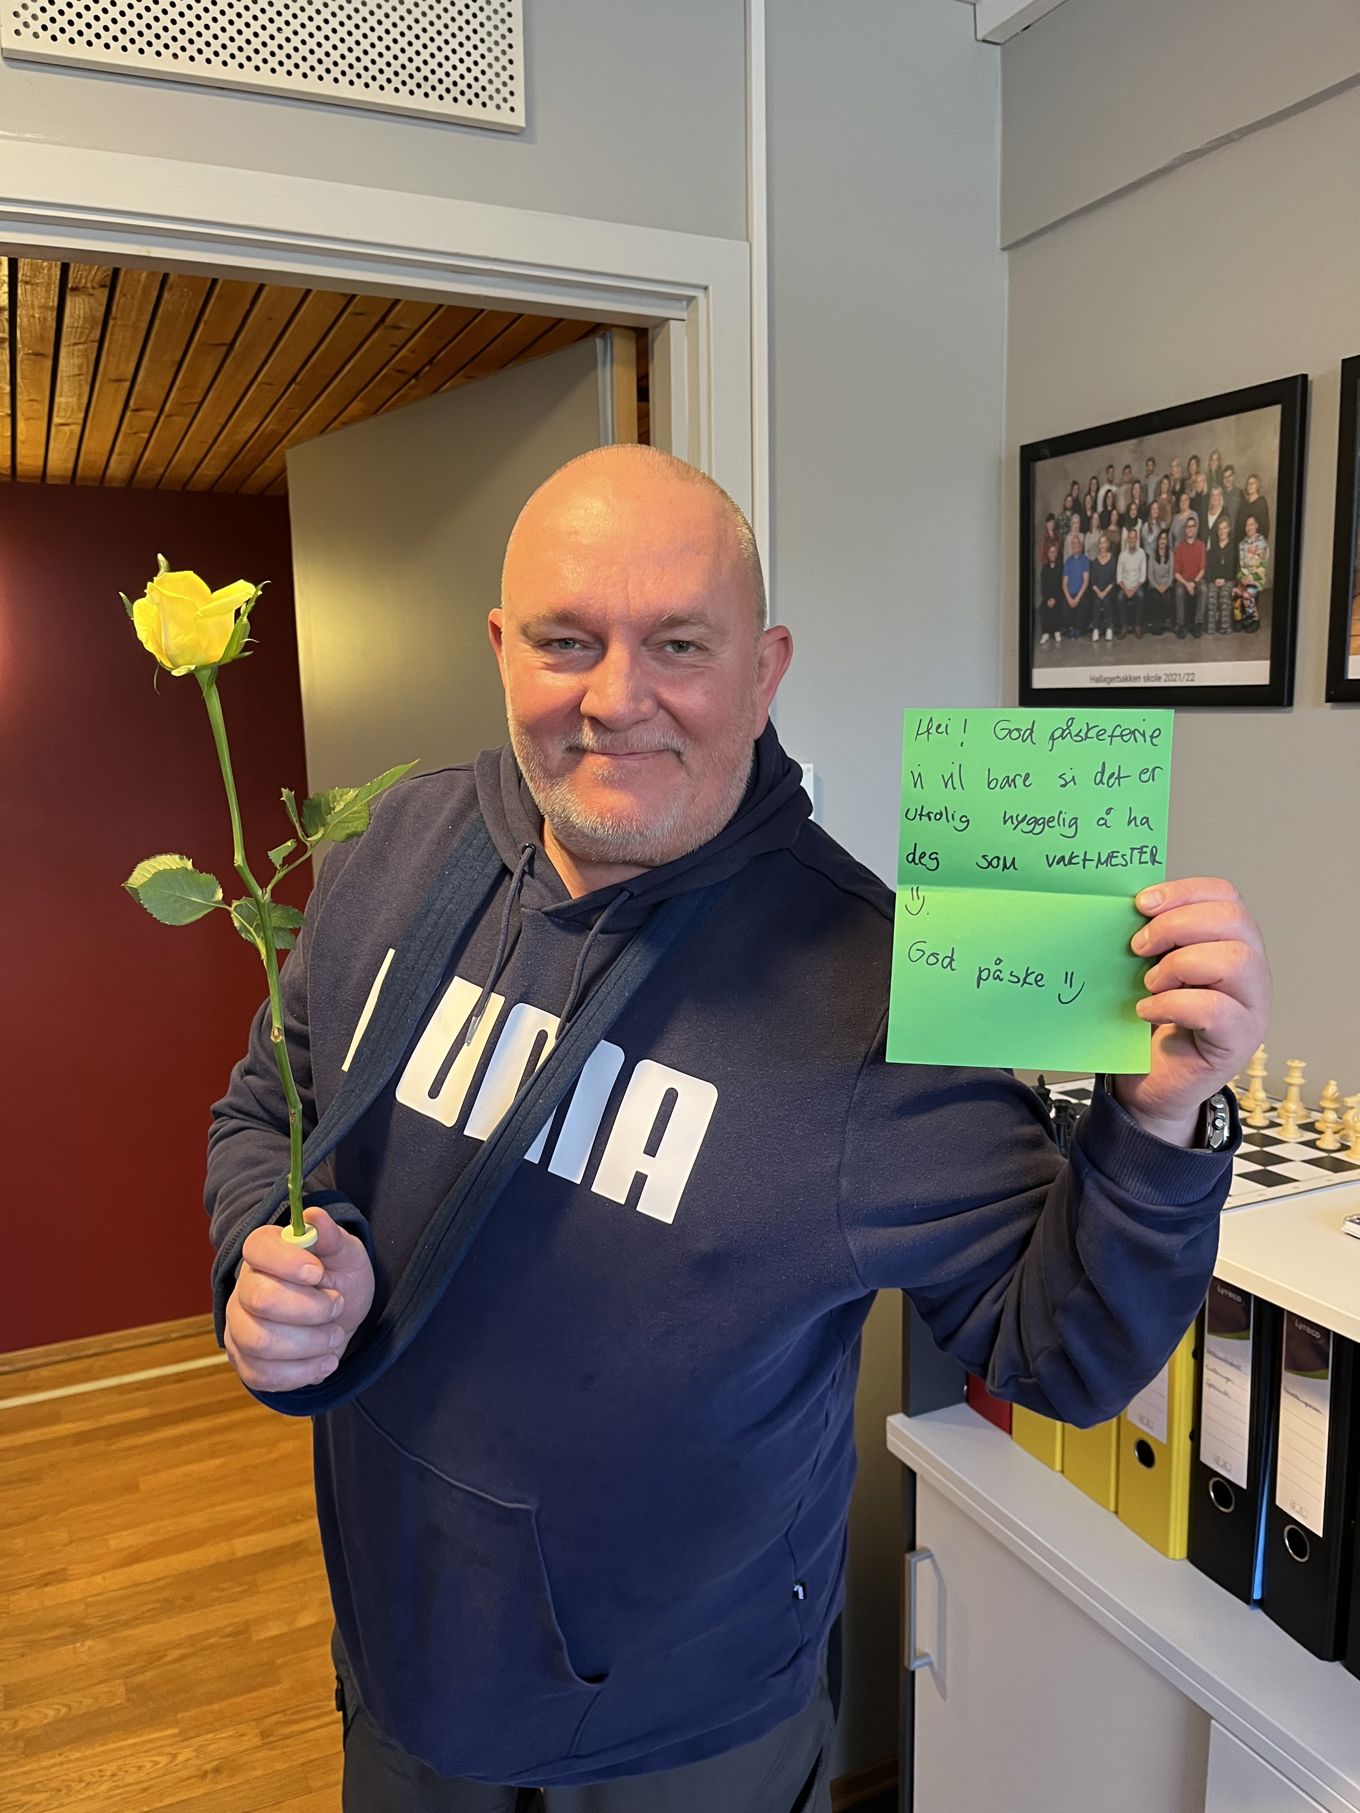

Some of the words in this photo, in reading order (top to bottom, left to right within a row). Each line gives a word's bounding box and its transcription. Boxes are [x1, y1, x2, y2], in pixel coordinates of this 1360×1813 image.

[1143, 672, 1162, 683] skole
[1163, 672, 1196, 683] 2021/22
[993, 719, 1037, 746] God
[1048, 716, 1162, 752] påskeferie
[986, 767, 1033, 791] bare
[1058, 767, 1077, 789] si
[1093, 761, 1131, 788] det
[1138, 765, 1164, 784] er
[1002, 809, 1079, 839] hyggelig
[1096, 807, 1114, 828] å
[1126, 806, 1154, 831] ha
[905, 842, 941, 871] deg
[907, 940, 957, 972] God
[976, 957, 1046, 989] påske
